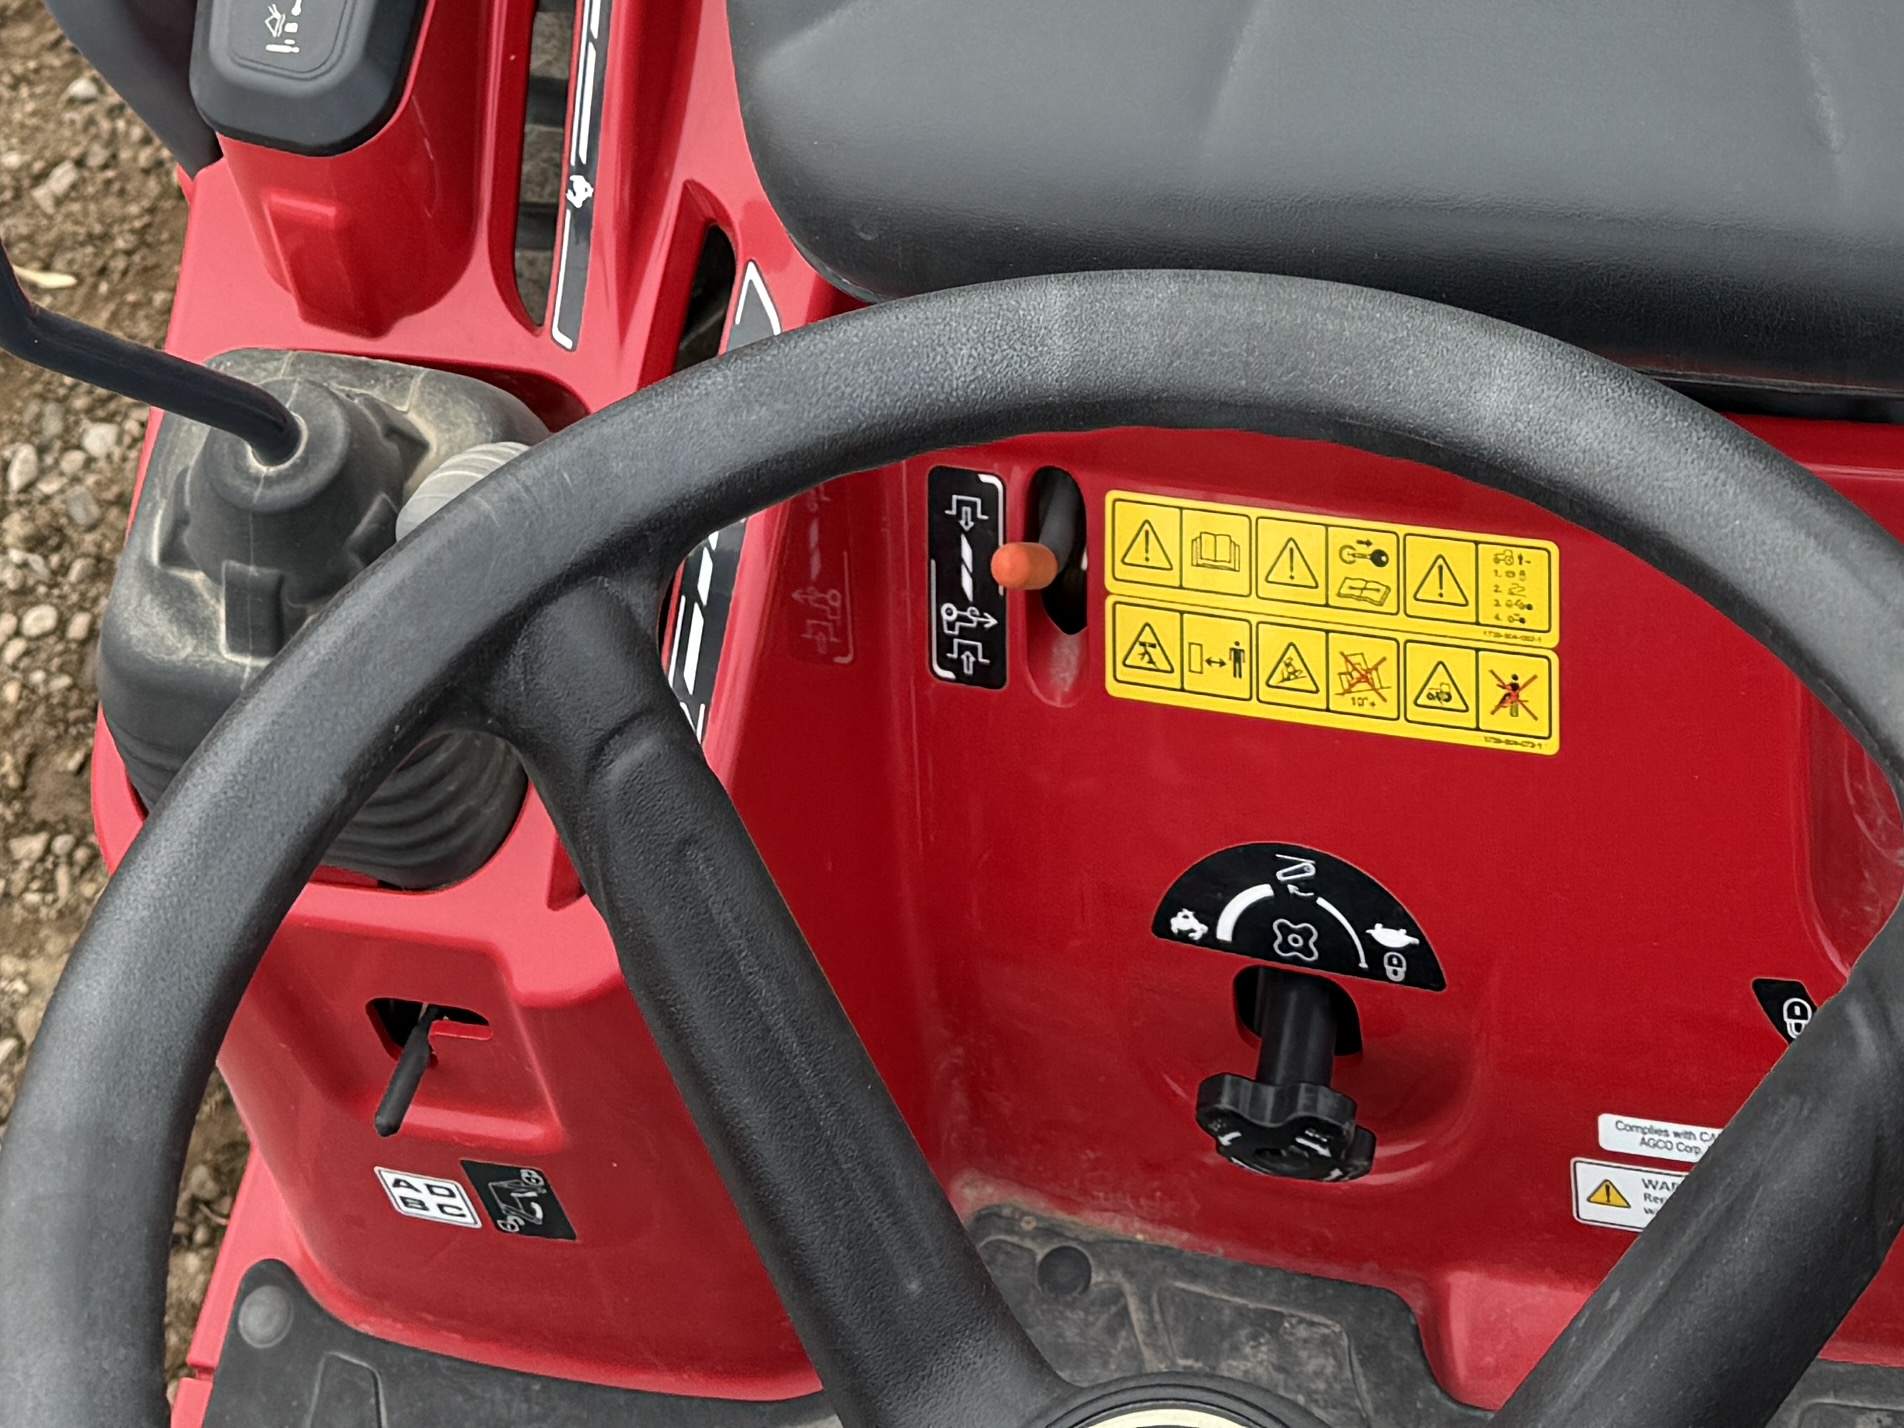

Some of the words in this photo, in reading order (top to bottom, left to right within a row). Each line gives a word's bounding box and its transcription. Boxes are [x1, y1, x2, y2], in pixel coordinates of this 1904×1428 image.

[1615, 1120, 1670, 1138] Complies
[1673, 1129, 1697, 1141] with
[1639, 1136, 1674, 1151] AGCO
[392, 1178, 423, 1194] A
[424, 1183, 457, 1199] D
[399, 1195, 430, 1212] B
[436, 1203, 467, 1218] C
